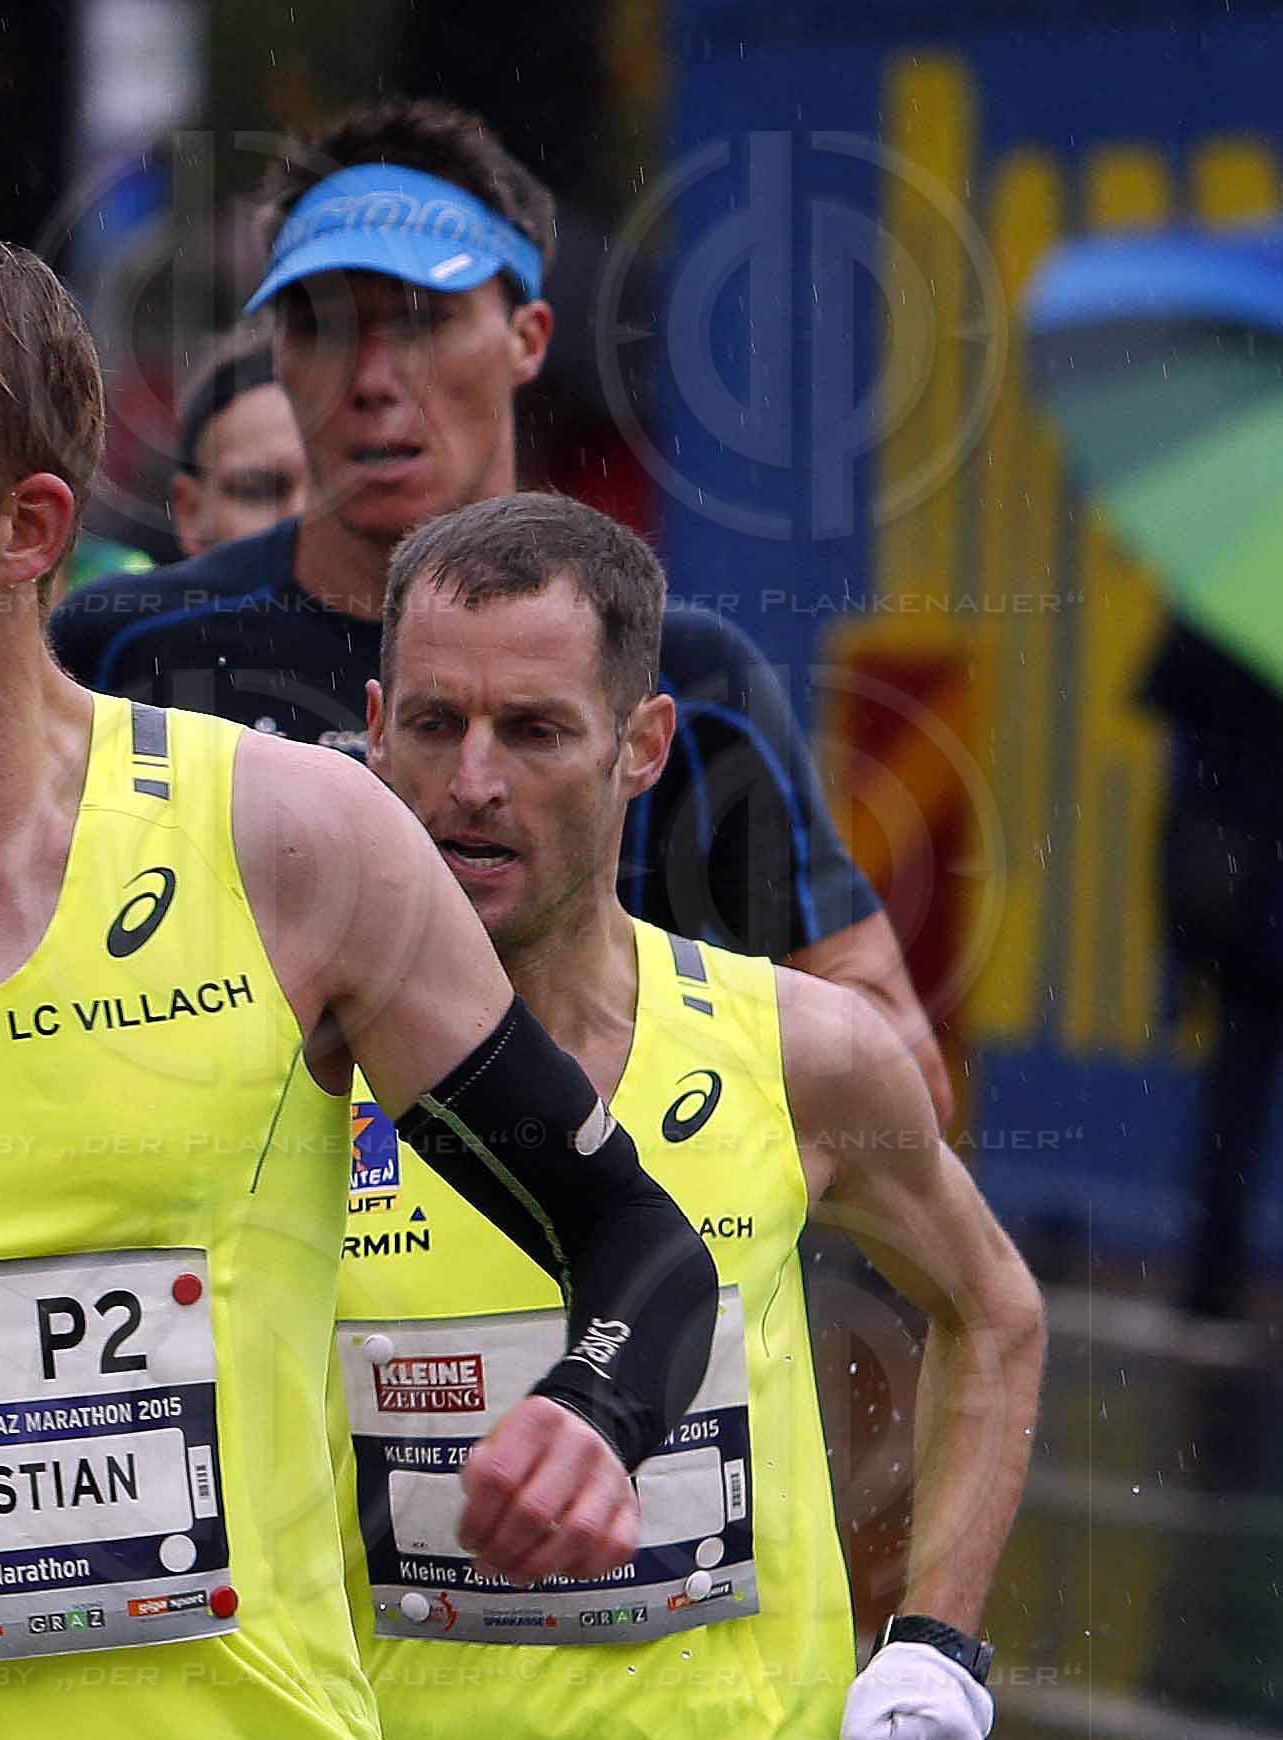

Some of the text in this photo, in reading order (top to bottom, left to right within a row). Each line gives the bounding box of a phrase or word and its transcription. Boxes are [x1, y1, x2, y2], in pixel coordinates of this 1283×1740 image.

[6, 974, 255, 1041] LC VILLACH
[699, 1217, 753, 1238] ACH
[36, 1289, 149, 1381] P2
[379, 1359, 479, 1386] KLEINE
[380, 1388, 484, 1411] ZEITUNG
[25, 1403, 132, 1433] MARATHON
[138, 1396, 182, 1420] 2015
[385, 1444, 445, 1466] KLEINE
[680, 1419, 720, 1442] 2015
[399, 1559, 457, 1584] Kleine
[29, 1610, 106, 1633] GRAZ
